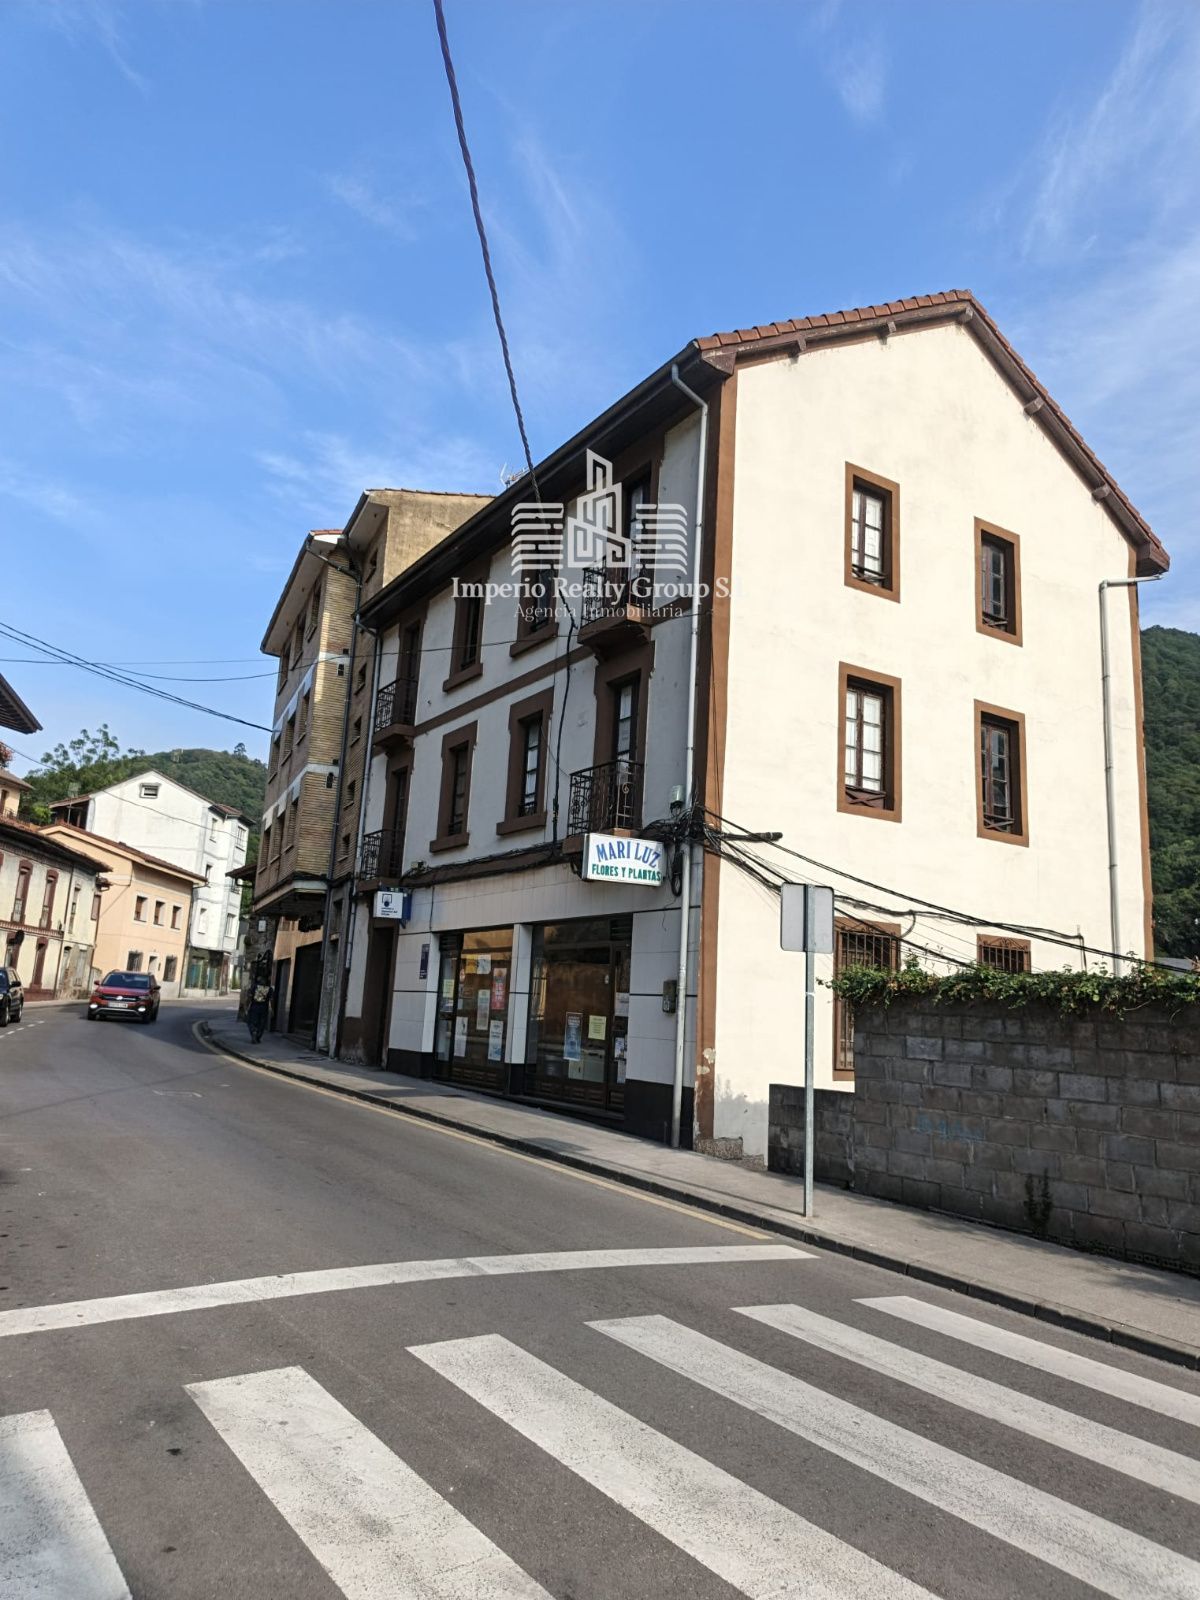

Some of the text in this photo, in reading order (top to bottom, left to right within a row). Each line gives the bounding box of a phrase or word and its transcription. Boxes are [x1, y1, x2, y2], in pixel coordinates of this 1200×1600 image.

[591, 863, 661, 882] FLORES Y PLANTAS
